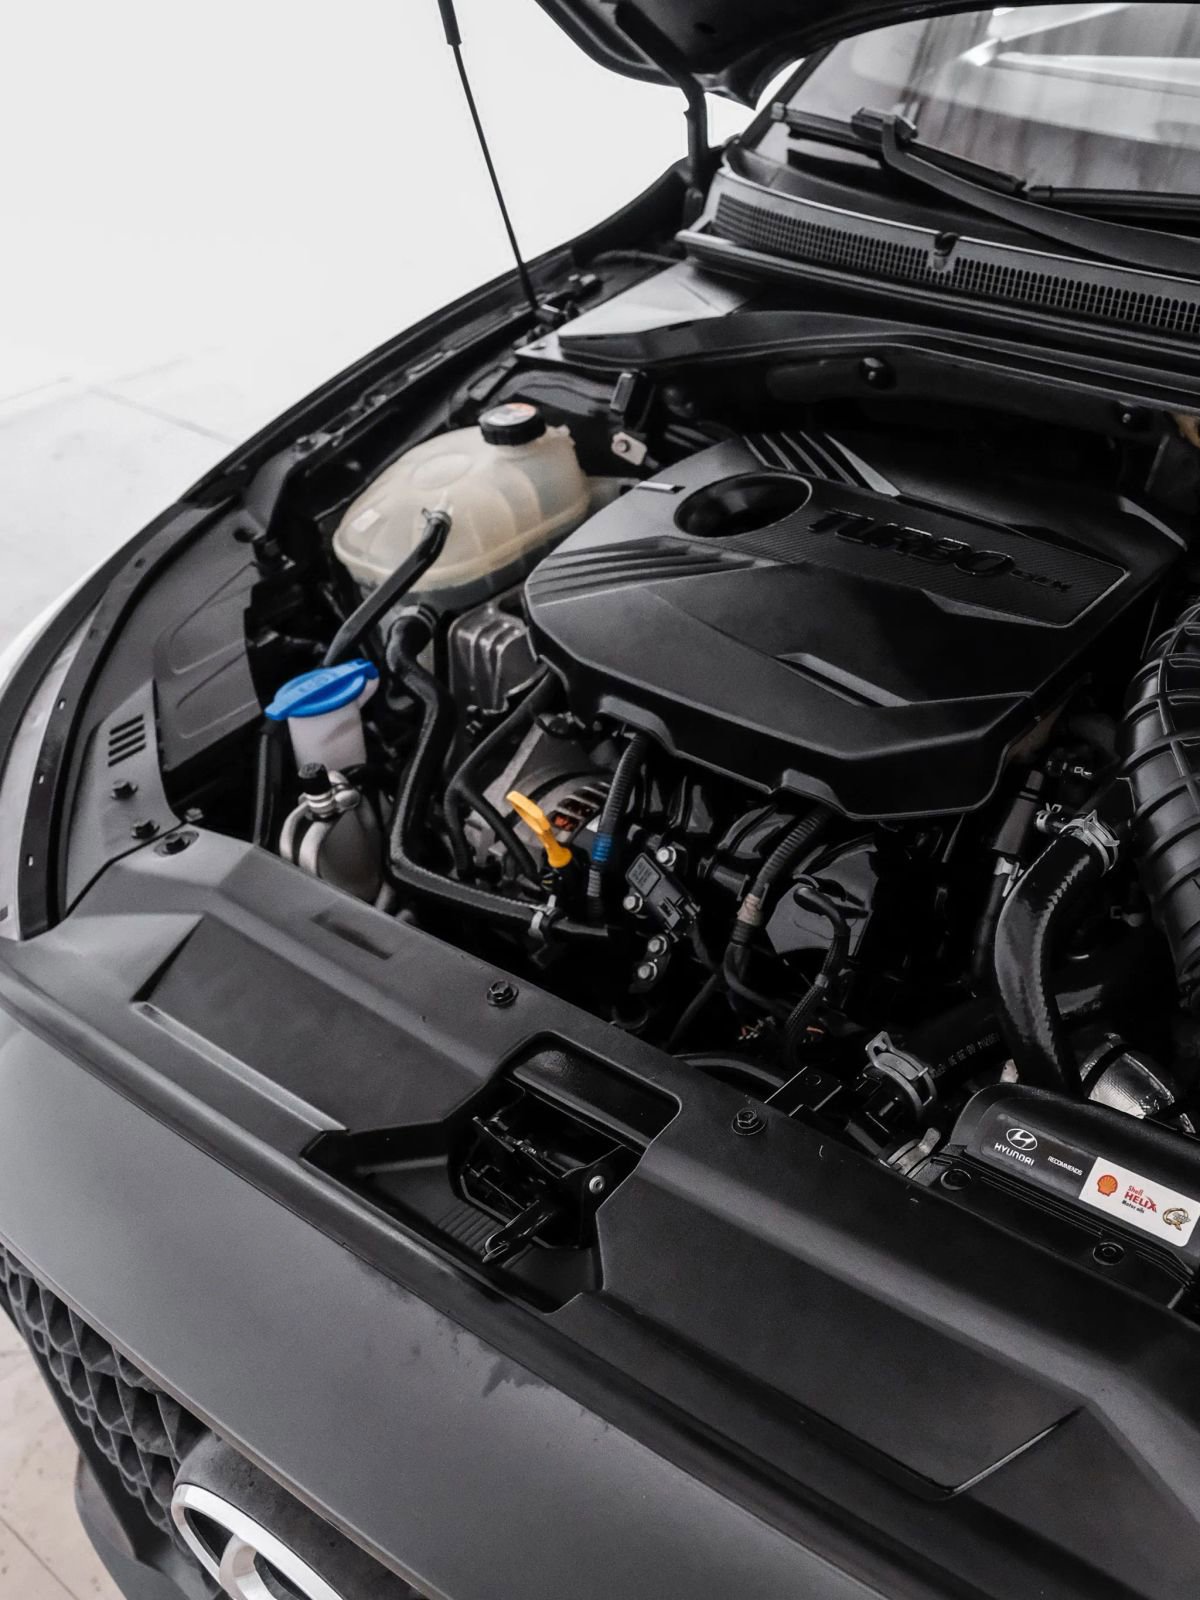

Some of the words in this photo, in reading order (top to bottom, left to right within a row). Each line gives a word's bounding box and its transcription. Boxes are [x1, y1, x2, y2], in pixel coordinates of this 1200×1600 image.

[808, 508, 1015, 577] TURBO
[994, 1142, 1035, 1167] HYUNDAI
[1047, 1155, 1083, 1176] RECOMMENDS
[1128, 1185, 1144, 1196] Shell
[1124, 1191, 1158, 1213] HELIX
